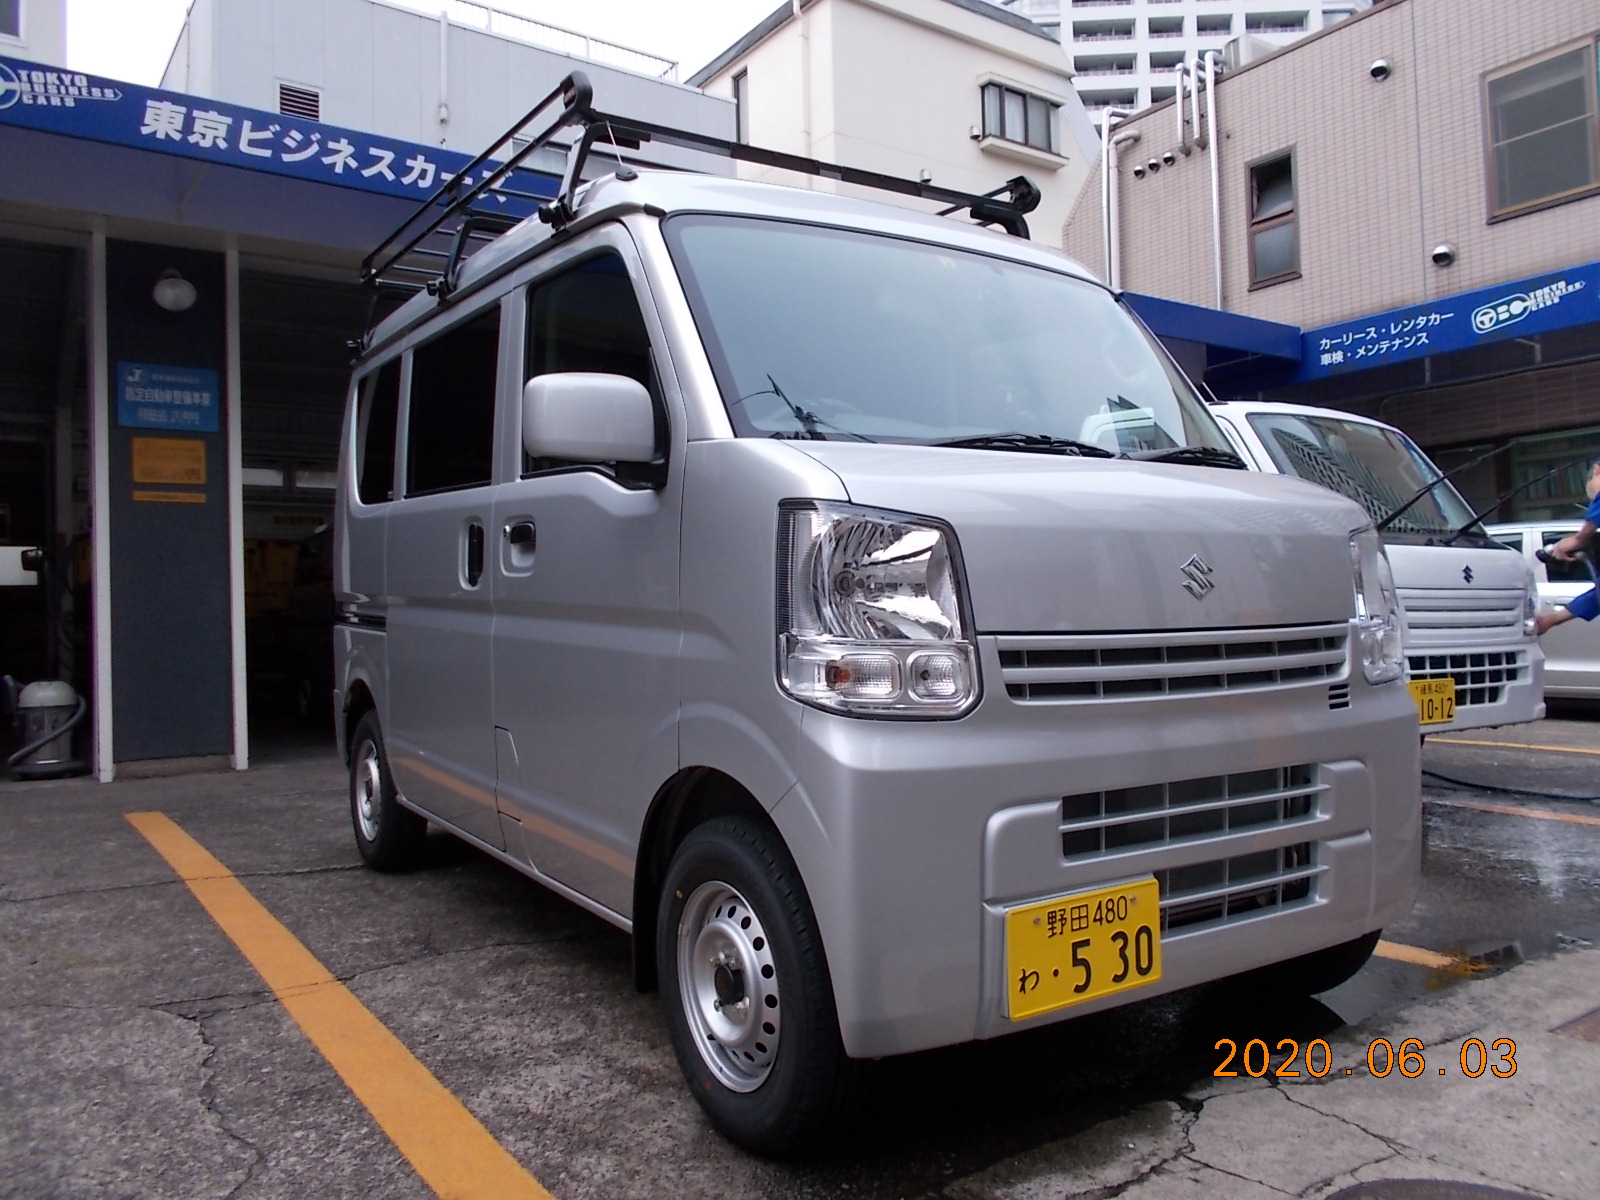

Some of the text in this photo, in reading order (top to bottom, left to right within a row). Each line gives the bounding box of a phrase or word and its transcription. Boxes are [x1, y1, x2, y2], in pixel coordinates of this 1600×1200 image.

[17, 69, 88, 87] TOKYO
[21, 82, 115, 98] BUSINESS
[22, 94, 76, 107] CARS
[140, 98, 513, 204] 東京ビジネスカーズ
[1529, 280, 1567, 300] TOKYO
[1319, 312, 1454, 351] カーリース・レンタカー
[1320, 332, 1430, 366] 車検・メンテナンス
